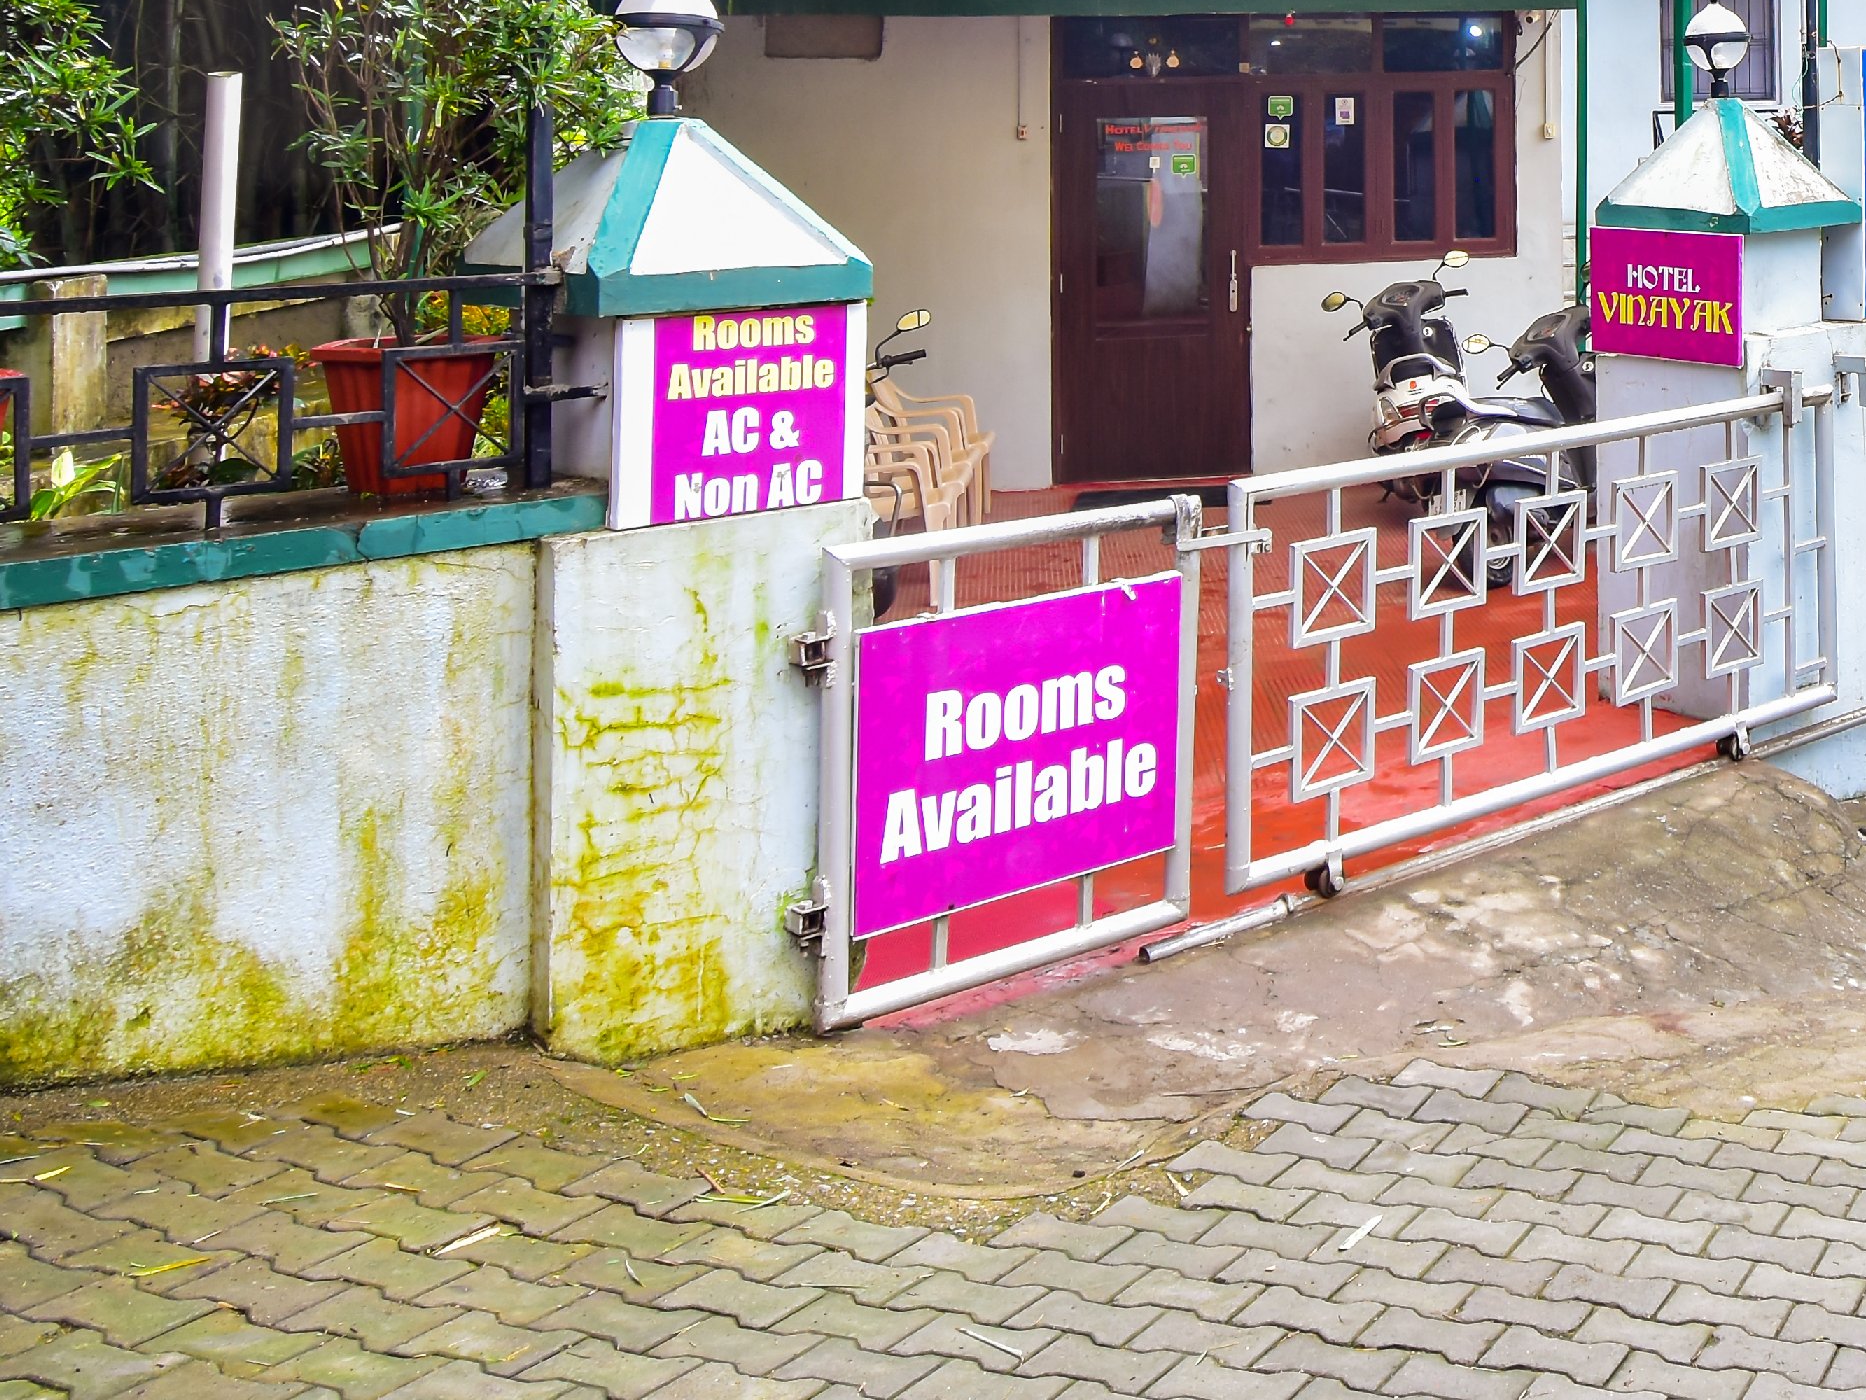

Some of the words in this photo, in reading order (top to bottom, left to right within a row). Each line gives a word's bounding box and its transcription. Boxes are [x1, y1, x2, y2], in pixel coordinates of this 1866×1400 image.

[1626, 263, 1701, 293] HOTEL
[692, 314, 815, 351] Rooms
[1597, 291, 1734, 335] VINAYAK
[667, 354, 835, 401] Available
[701, 406, 760, 457] AC
[769, 410, 800, 450] &
[674, 471, 760, 521] Non
[766, 459, 823, 510] AC
[924, 664, 1127, 762] Rooms
[880, 738, 1158, 865] Available
